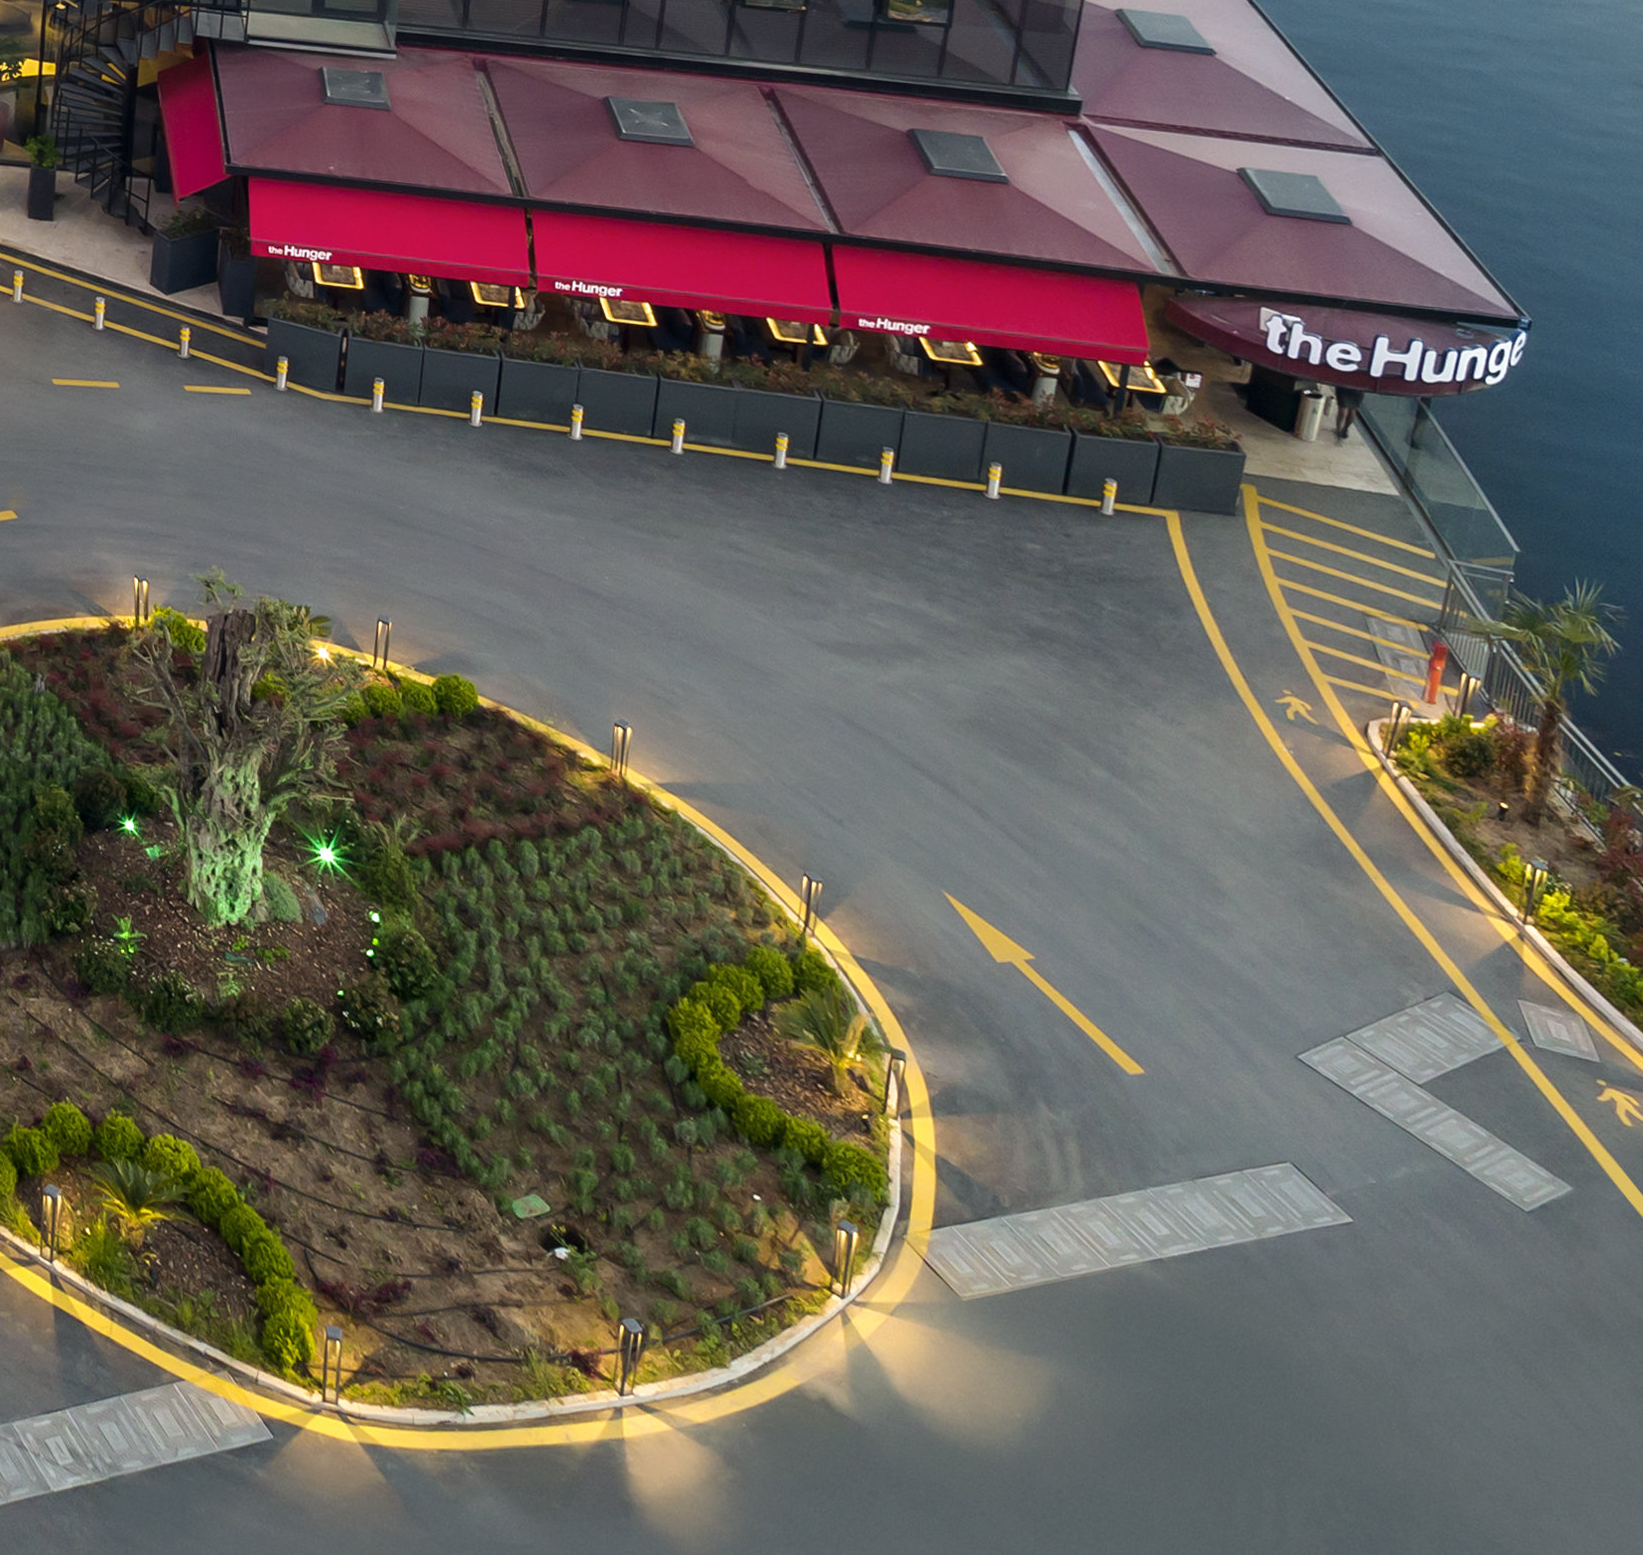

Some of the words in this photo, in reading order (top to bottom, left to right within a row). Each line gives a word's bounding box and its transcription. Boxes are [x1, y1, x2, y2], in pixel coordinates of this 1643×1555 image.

[268, 245, 283, 255] the
[284, 244, 332, 261] Hunger
[554, 281, 571, 290] the
[571, 280, 623, 297] Hunger
[858, 318, 875, 328] the
[876, 317, 931, 335] Hunger
[1265, 314, 1363, 372] the
